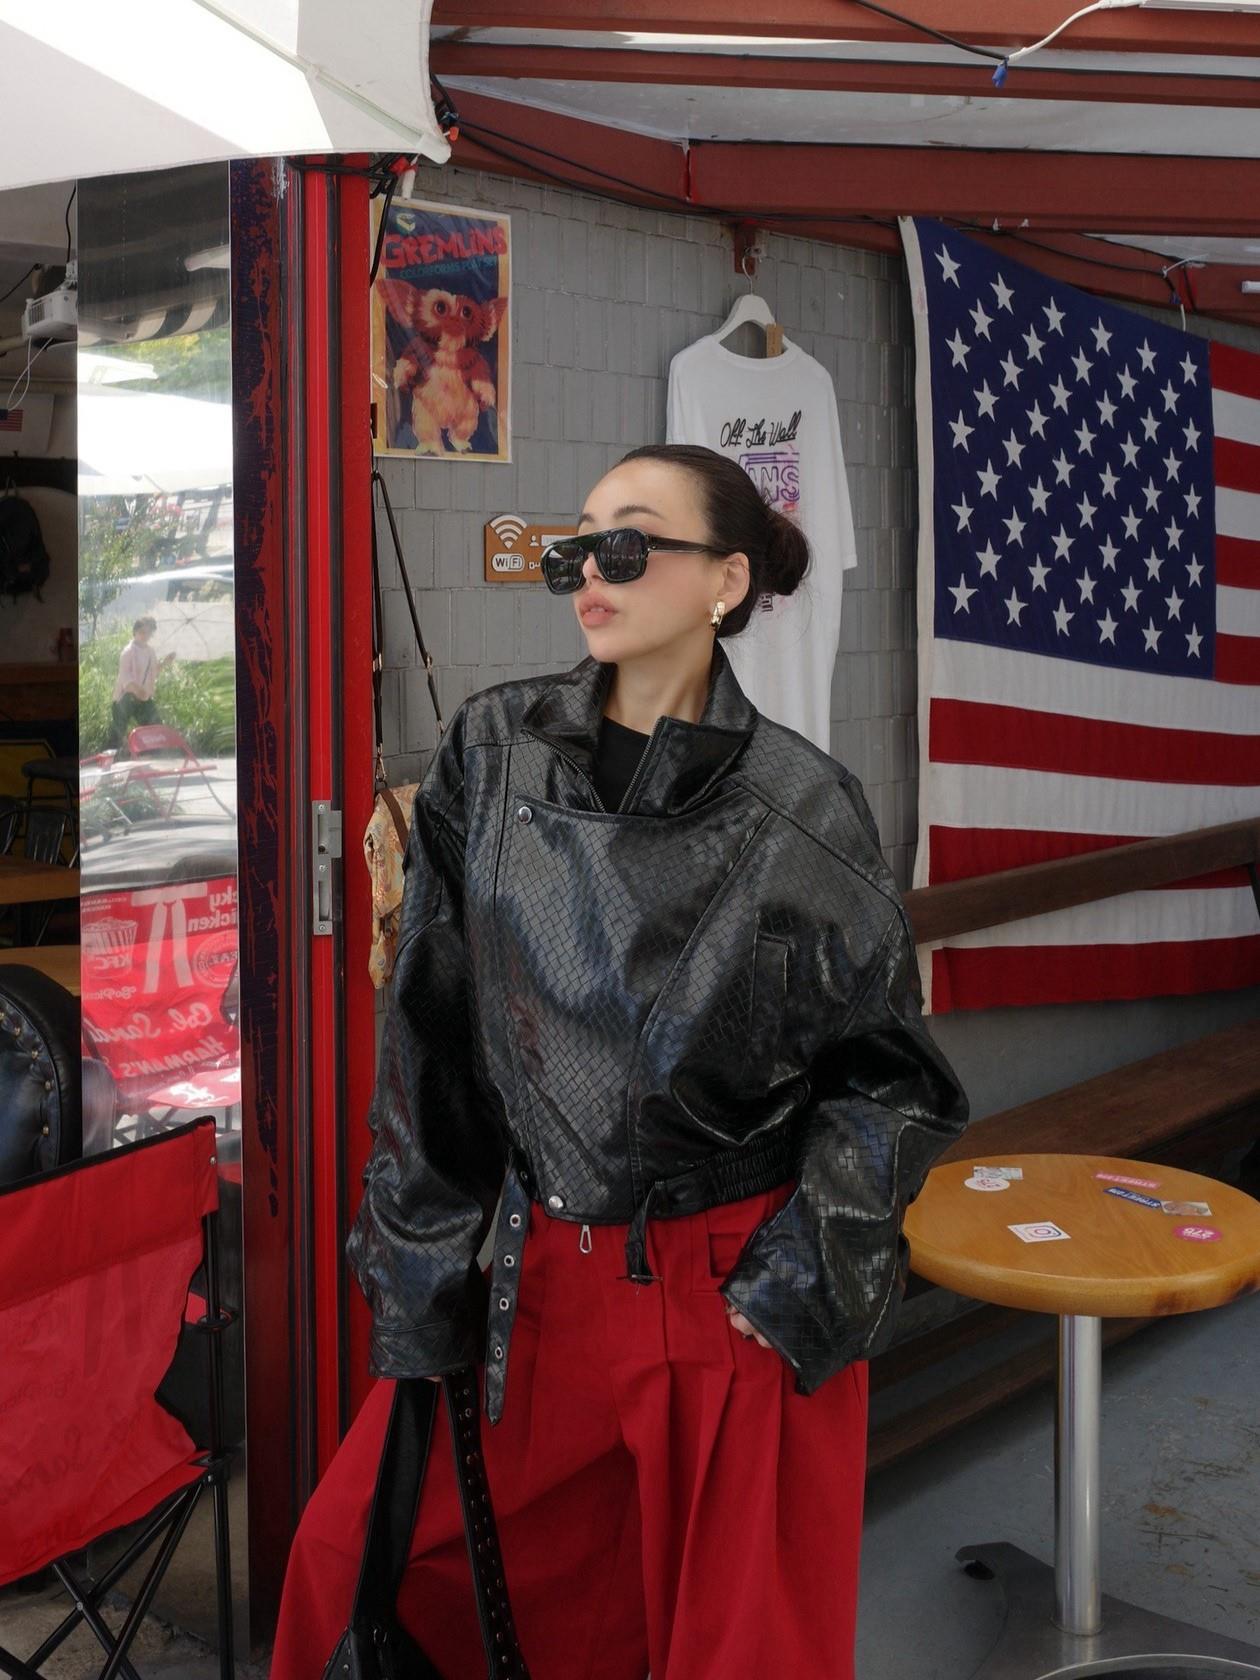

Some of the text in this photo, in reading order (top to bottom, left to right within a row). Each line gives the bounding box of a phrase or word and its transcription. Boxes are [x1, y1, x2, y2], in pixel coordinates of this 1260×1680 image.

[720, 409, 801, 448] Off The Wall
